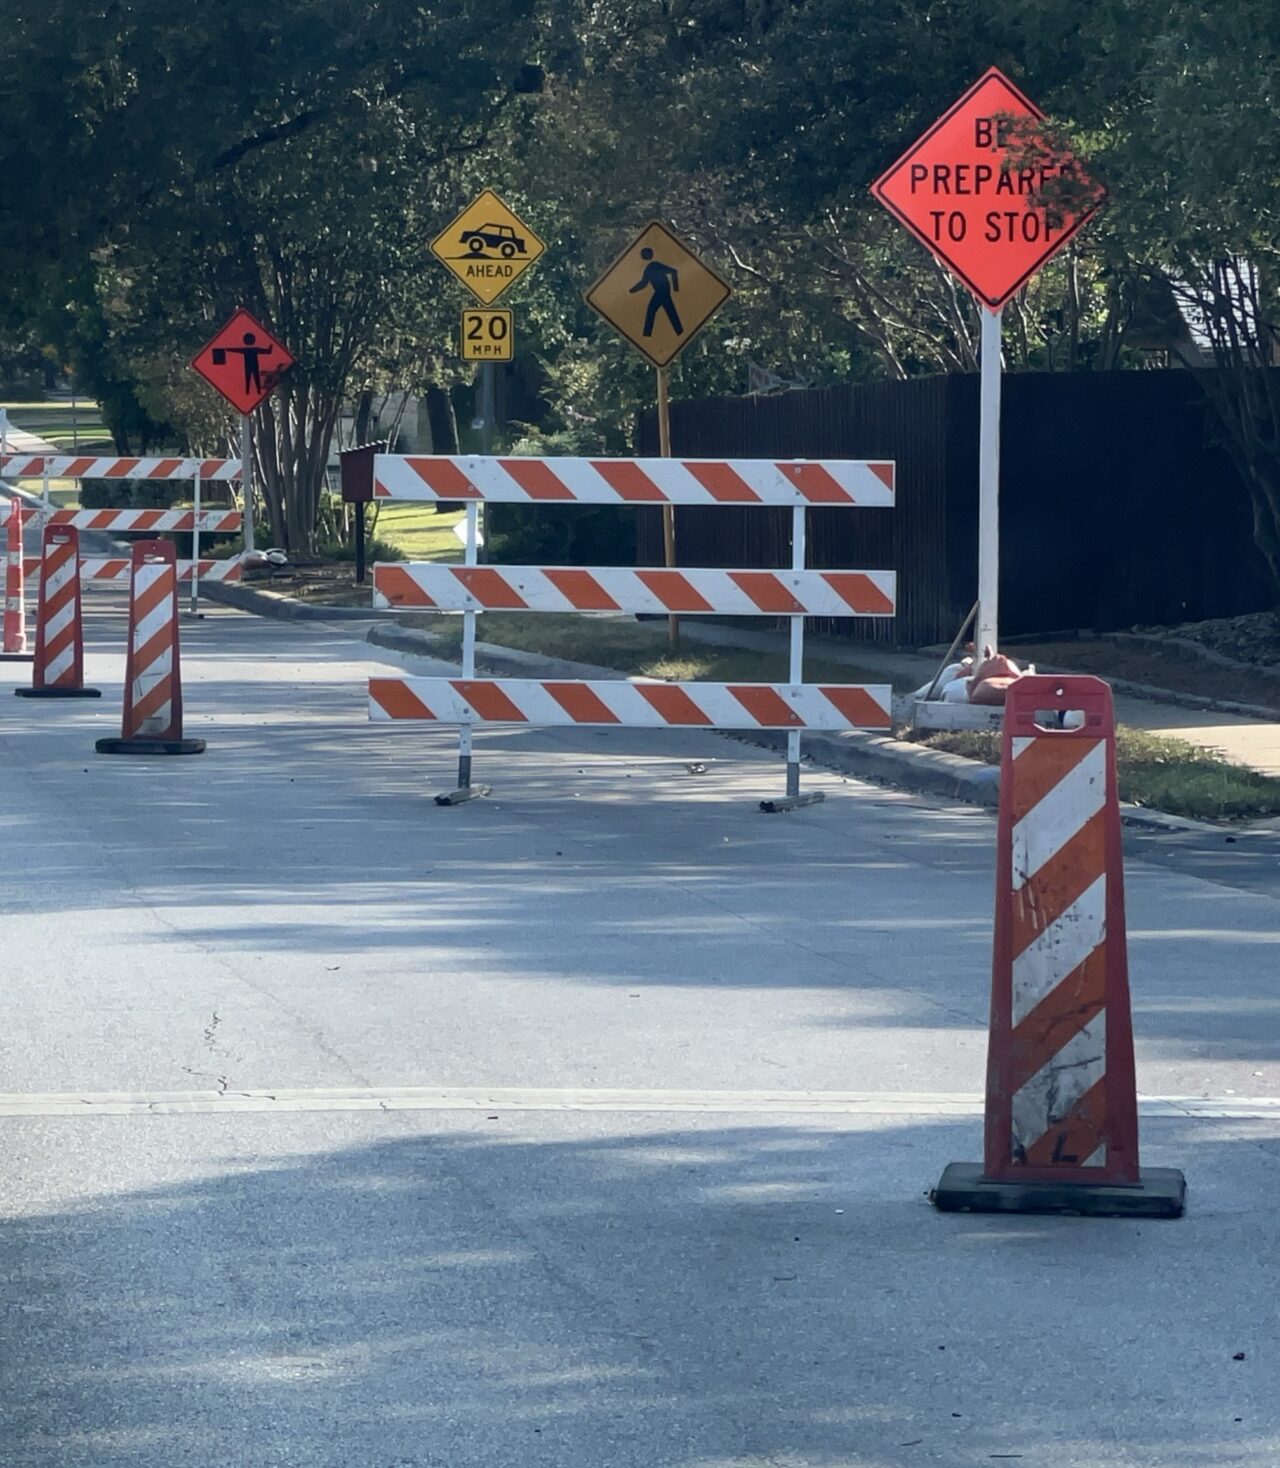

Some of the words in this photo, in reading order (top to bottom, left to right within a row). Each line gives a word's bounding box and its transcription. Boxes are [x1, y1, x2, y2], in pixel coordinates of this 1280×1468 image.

[910, 164, 1073, 195] PREPARE
[930, 211, 967, 242] TO
[466, 264, 513, 278] AHEAD
[467, 315, 507, 341] 20
[472, 345, 502, 355] MPH
